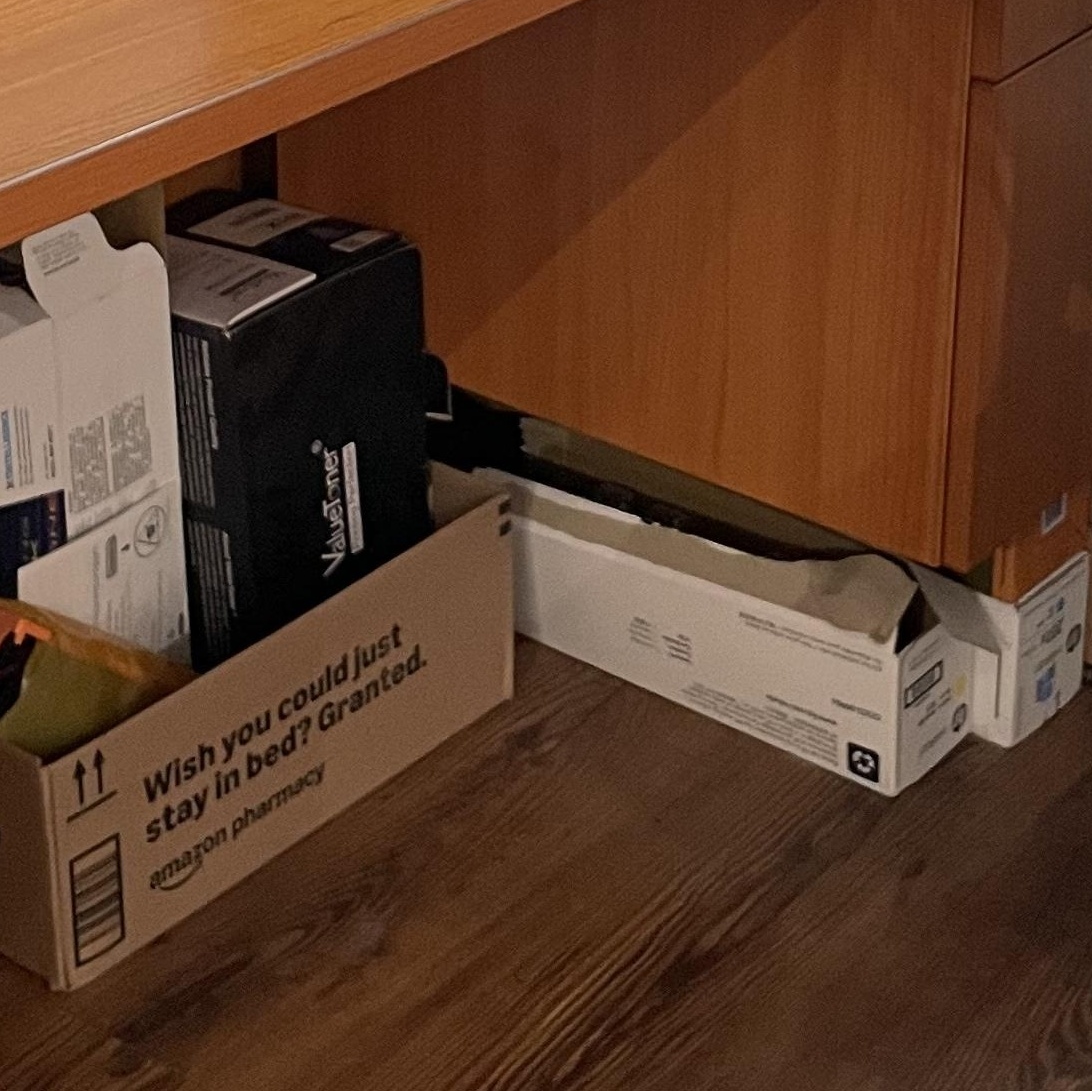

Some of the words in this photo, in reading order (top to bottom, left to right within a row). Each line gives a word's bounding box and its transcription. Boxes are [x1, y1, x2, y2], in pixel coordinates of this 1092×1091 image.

[321, 446, 346, 577] ValueToner
[143, 742, 216, 803] Wish
[221, 709, 271, 764] you
[277, 653, 349, 722] could
[352, 623, 403, 681] just
[145, 786, 209, 843] stay
[214, 767, 240, 800] in
[246, 716, 312, 780] bed?
[318, 643, 427, 732] Granted.
[150, 822, 228, 890] amazon
[231, 761, 325, 839] pharmacy
